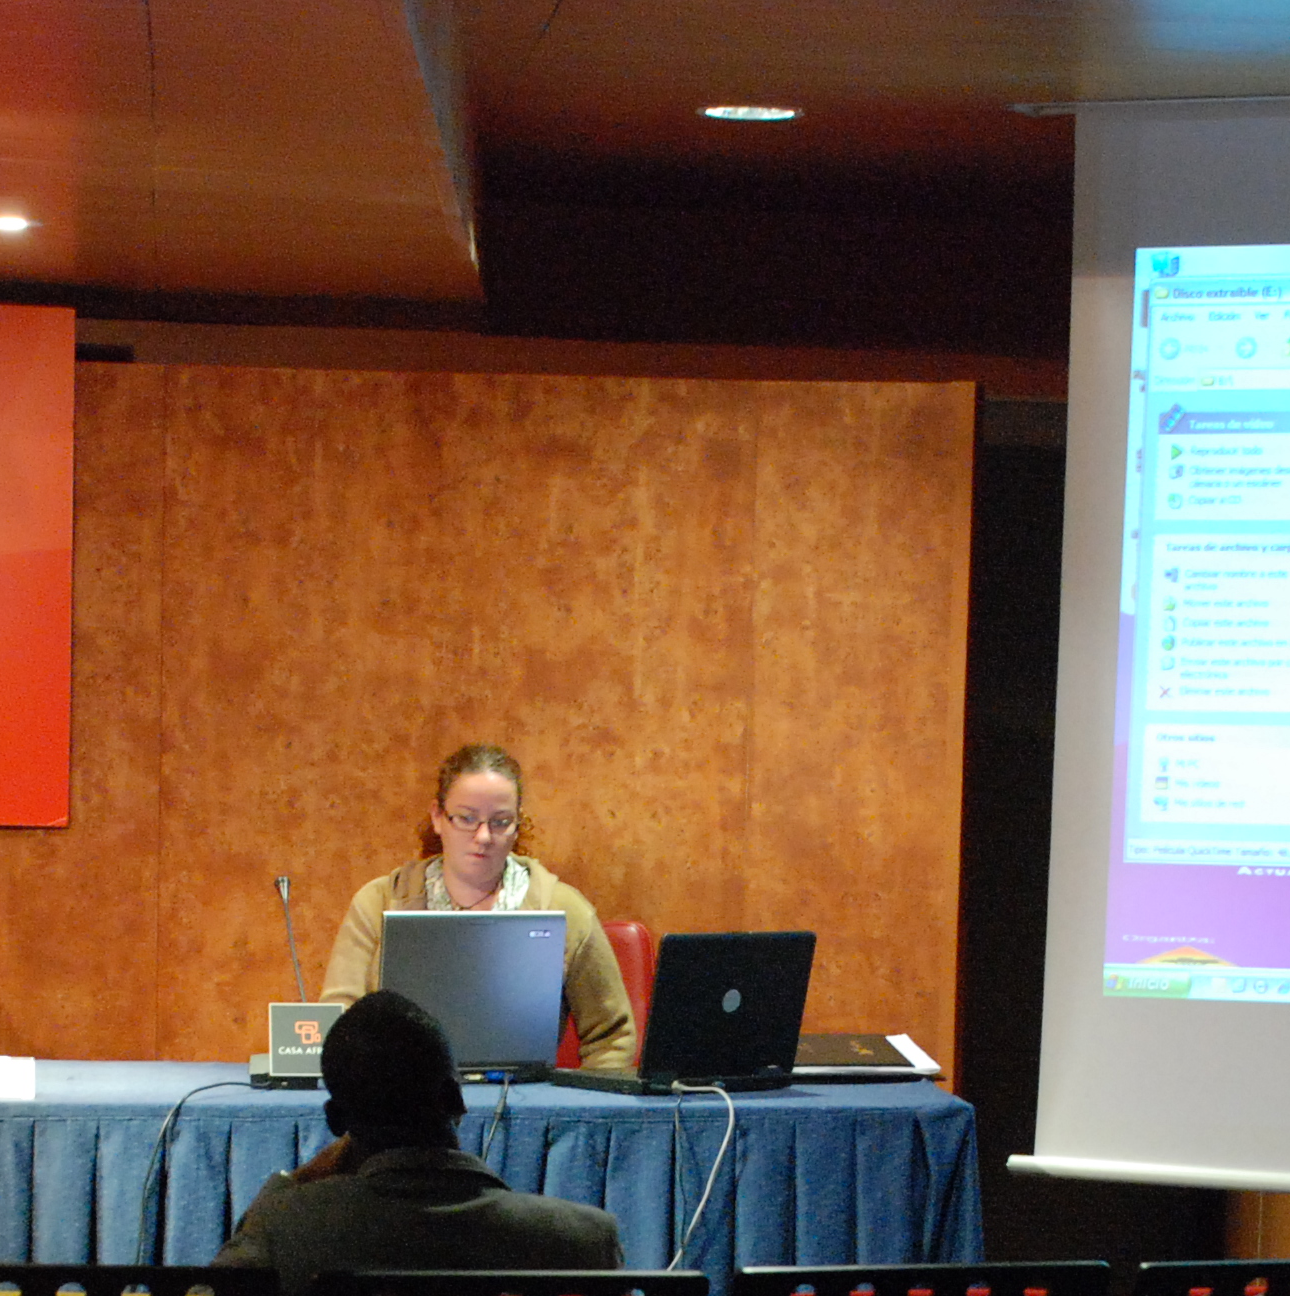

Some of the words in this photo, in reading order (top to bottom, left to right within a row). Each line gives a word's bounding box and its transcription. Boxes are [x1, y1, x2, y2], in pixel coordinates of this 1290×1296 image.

[1172, 288, 1203, 299] Disco
[1127, 976, 1171, 991] Inicio
[278, 1046, 304, 1055] CASA
[305, 1046, 323, 1055] AFR
